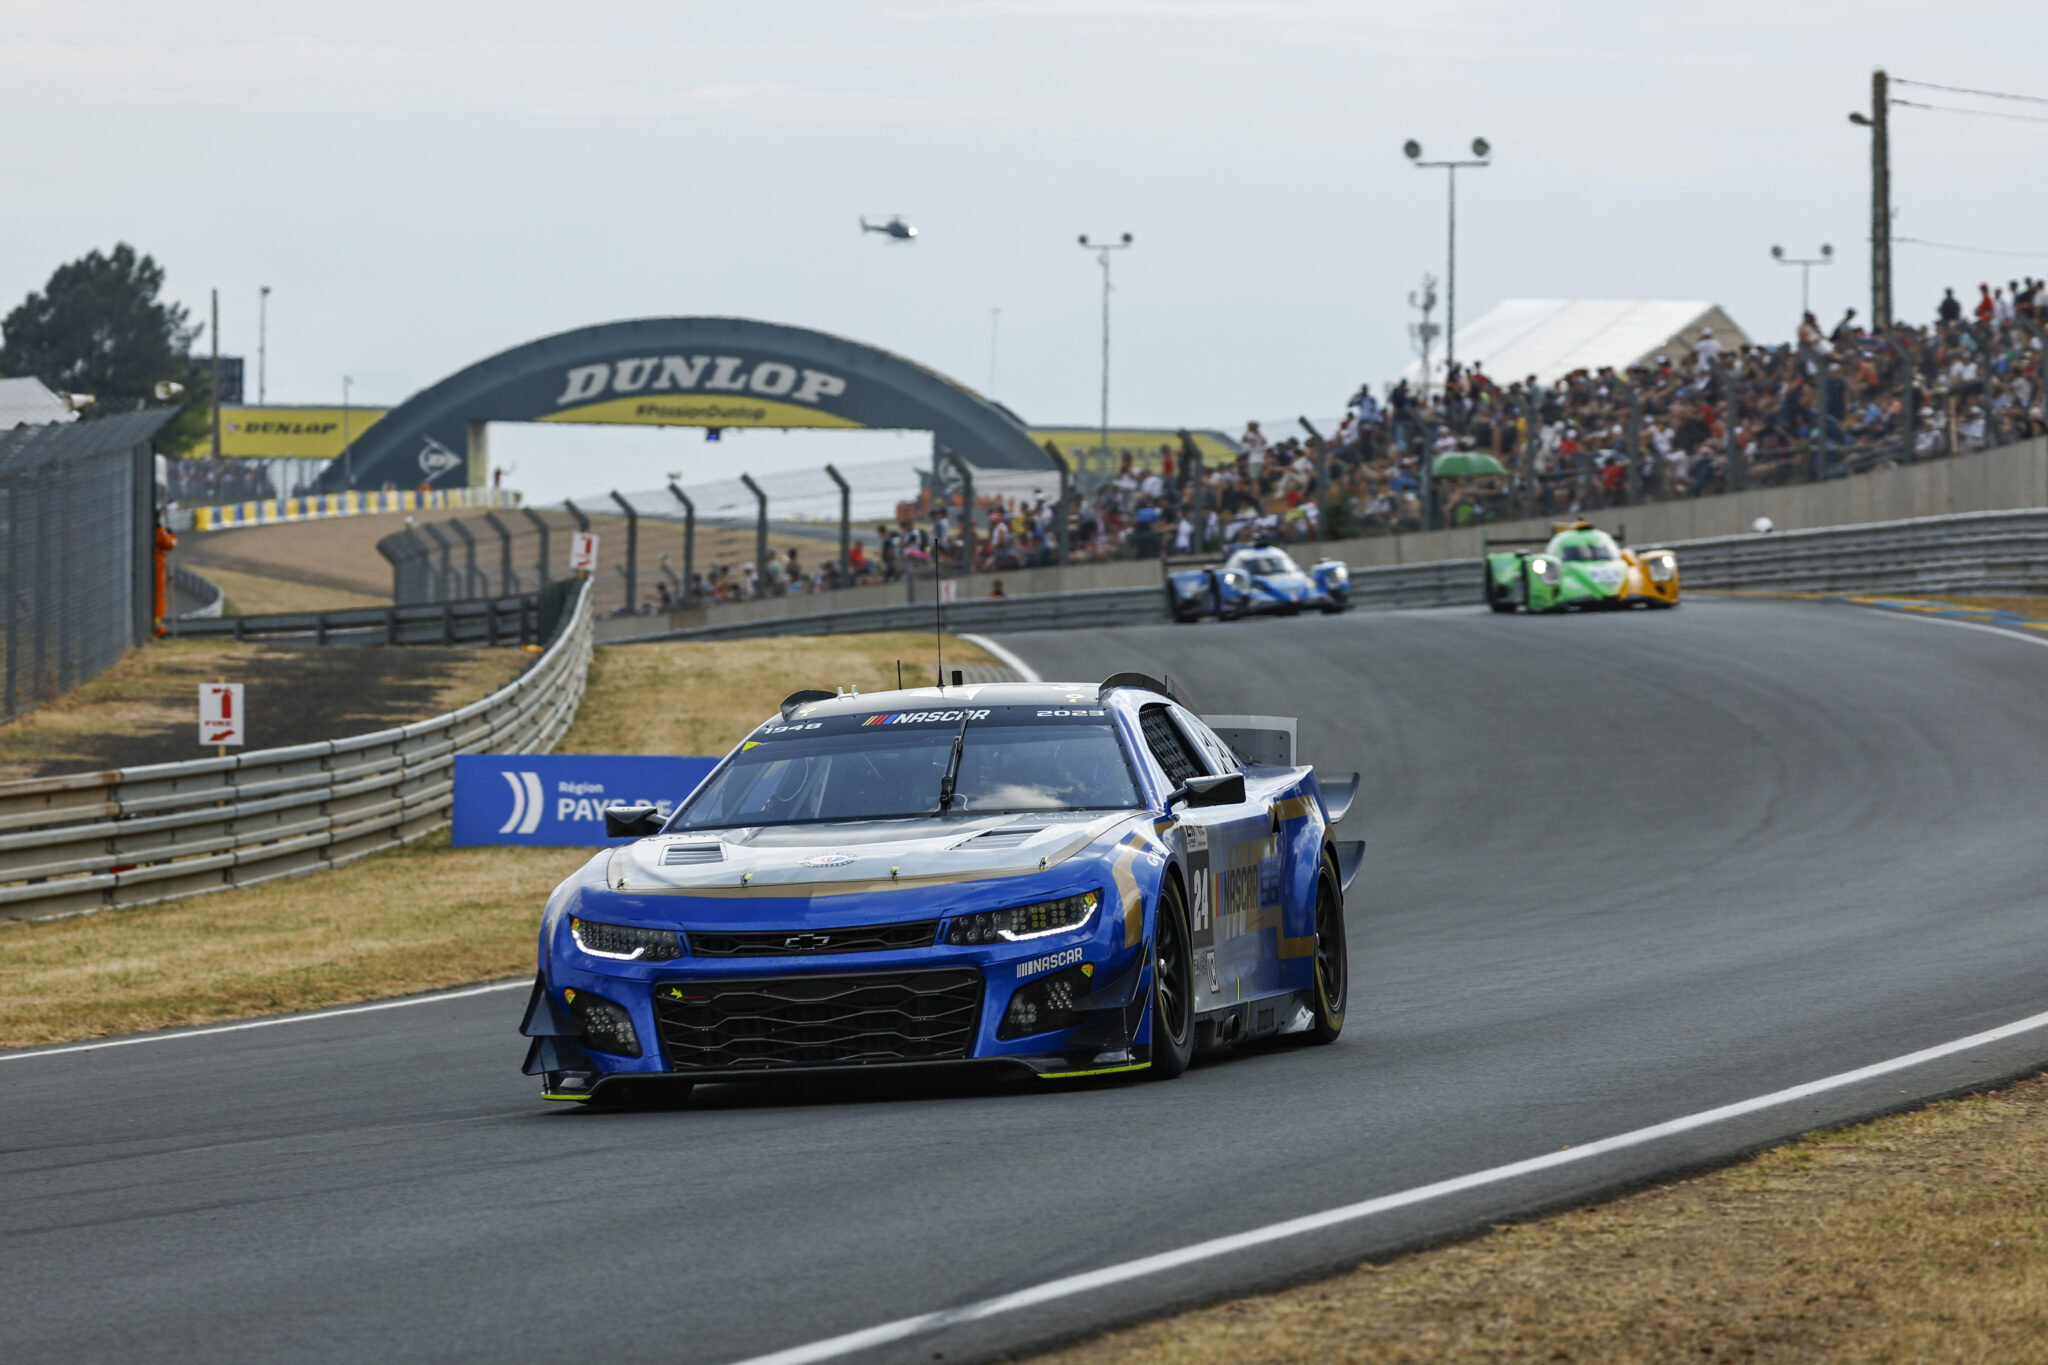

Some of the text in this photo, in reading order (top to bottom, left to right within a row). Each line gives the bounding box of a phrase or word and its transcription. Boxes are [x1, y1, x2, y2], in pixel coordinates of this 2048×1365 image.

[556, 355, 847, 405] DUNLOP
[244, 421, 338, 435] DUNLOP
[891, 709, 991, 725] NASCAR
[558, 781, 604, 796] Région
[1193, 867, 1208, 931] 24
[1224, 863, 1258, 916] NASCAR
[1032, 947, 1083, 974] NASCAR
